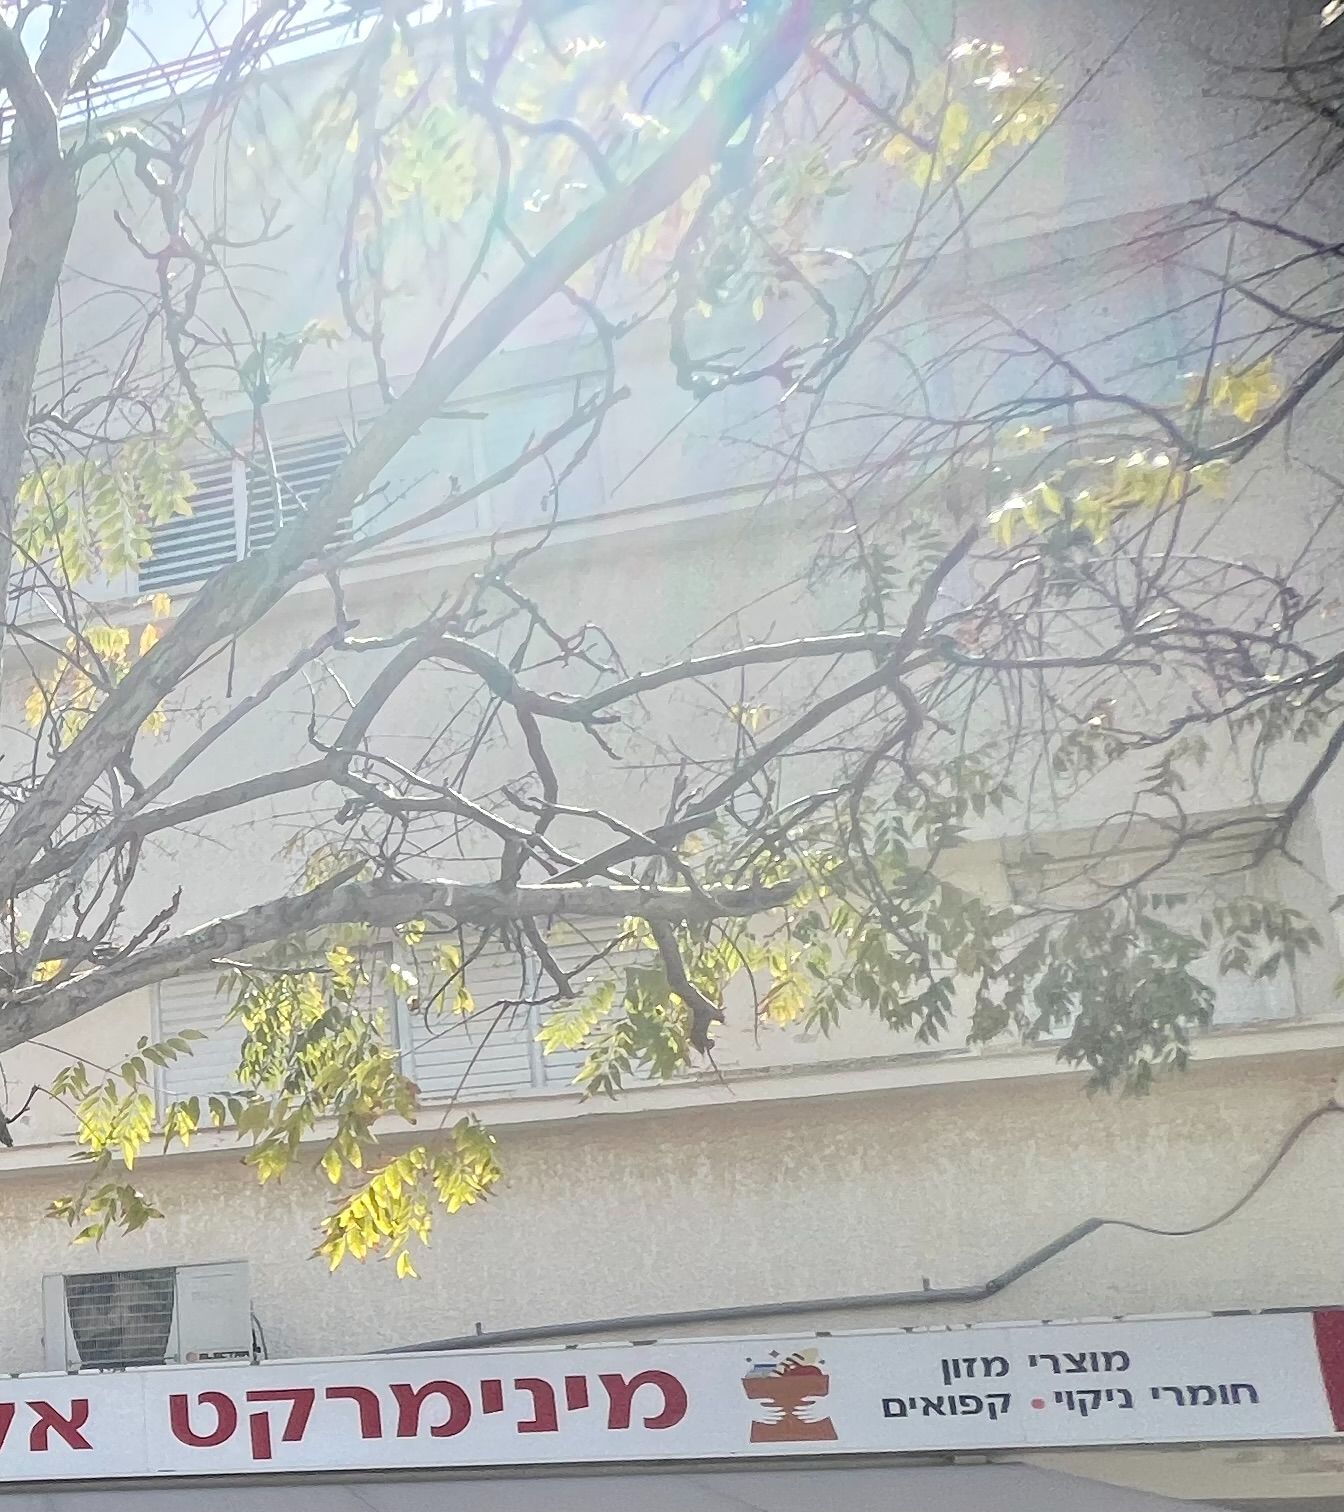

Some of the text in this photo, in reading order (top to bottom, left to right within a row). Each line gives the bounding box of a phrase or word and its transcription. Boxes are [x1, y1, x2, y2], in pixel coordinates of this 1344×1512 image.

[941, 1350, 1131, 1385] מוצרי מזון
[169, 1369, 689, 1460] מינימרקט
[881, 1382, 1259, 1420] חומרי ניקוי קפואים
